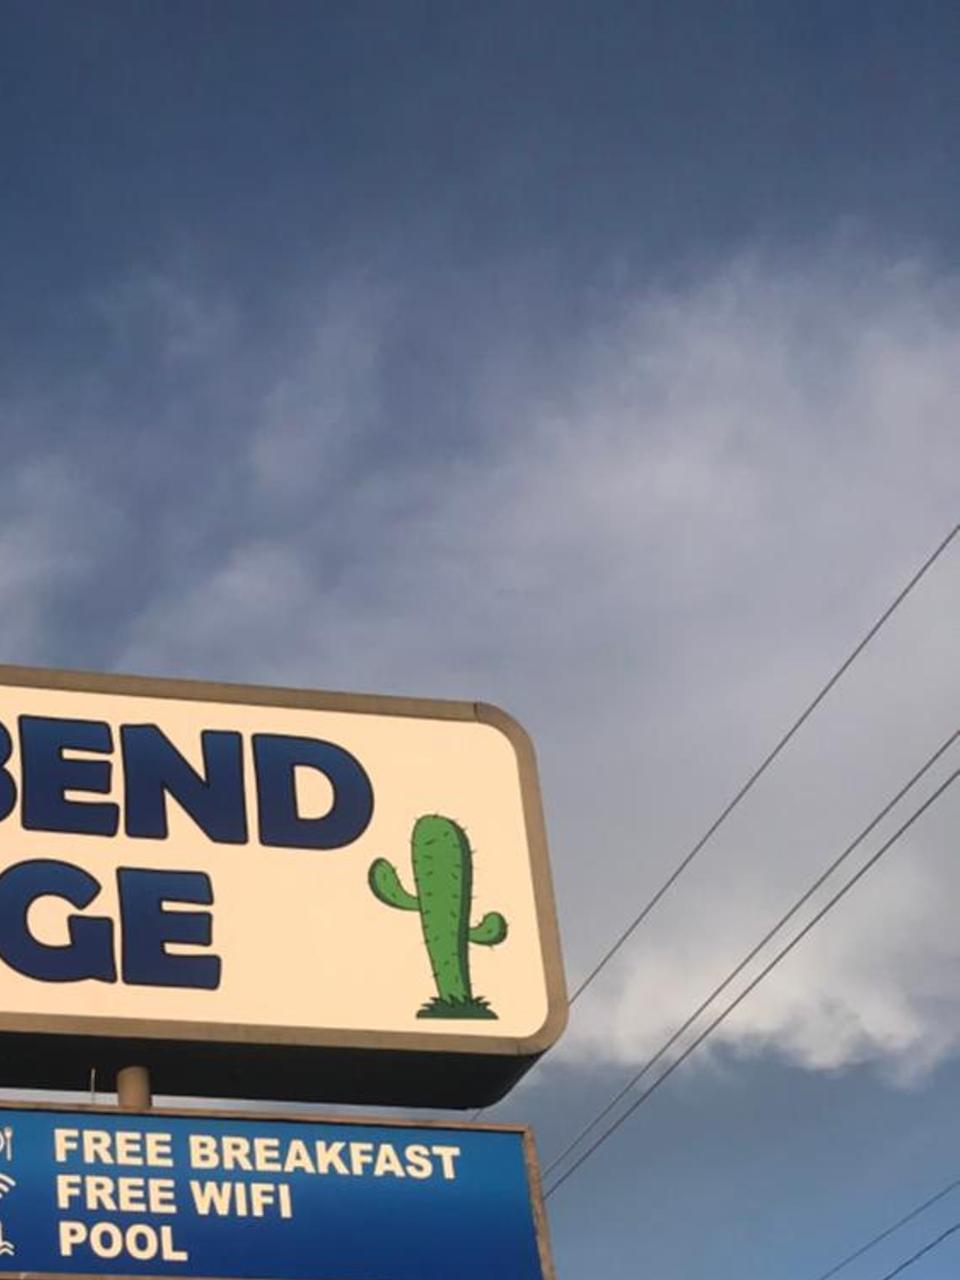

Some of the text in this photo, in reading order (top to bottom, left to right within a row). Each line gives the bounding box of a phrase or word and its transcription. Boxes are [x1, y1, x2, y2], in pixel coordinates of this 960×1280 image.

[54, 1127, 461, 1180] FREE BREAKFAST
[56, 1174, 293, 1219] FREE WIFI
[58, 1220, 189, 1262] POOL
